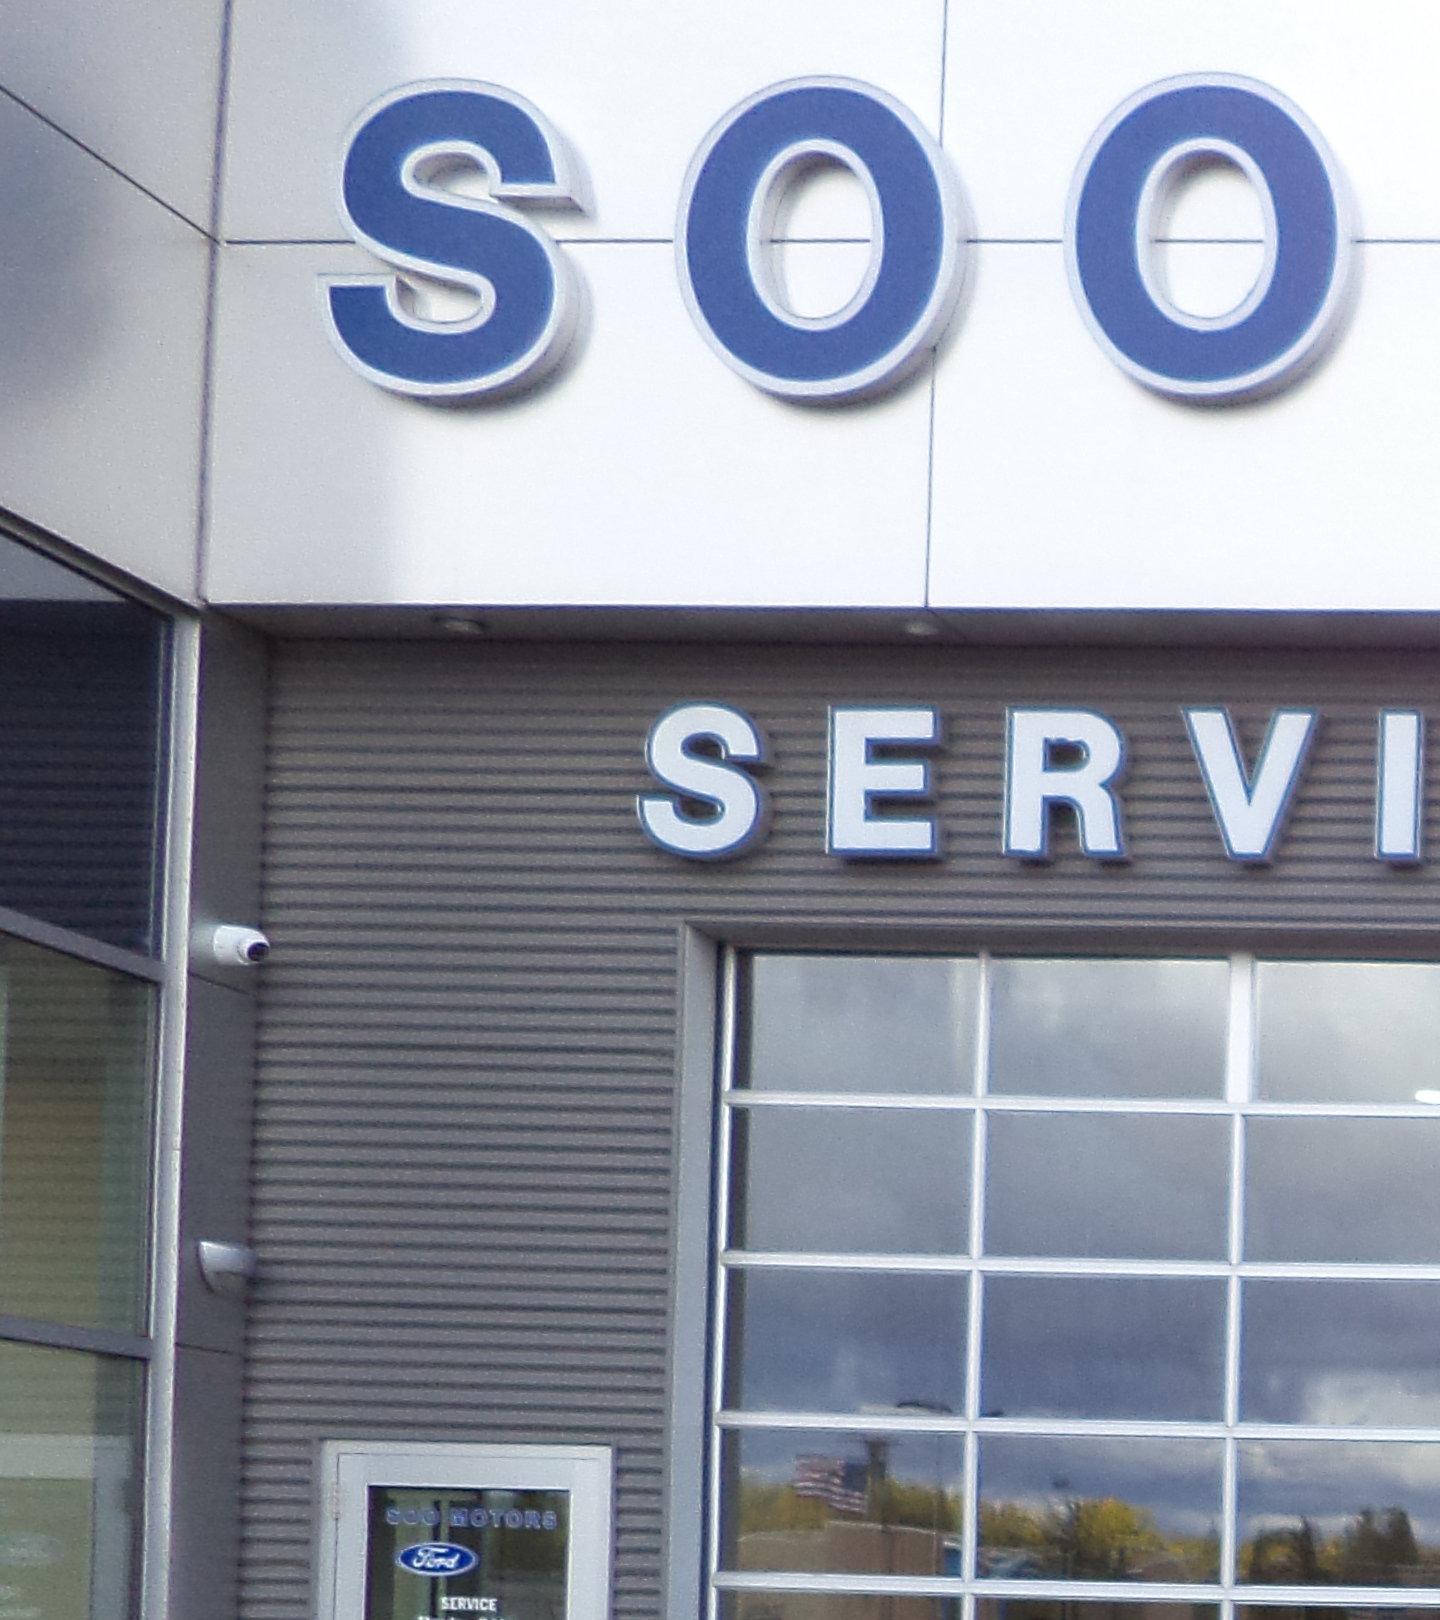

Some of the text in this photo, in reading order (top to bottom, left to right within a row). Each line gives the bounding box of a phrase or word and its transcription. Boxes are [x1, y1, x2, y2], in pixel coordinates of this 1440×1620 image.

[325, 74, 1352, 398] SOO
[386, 1507, 557, 1530] SOO MOTORS
[413, 1547, 460, 1568] Ford
[441, 1597, 498, 1612] SERVICE
